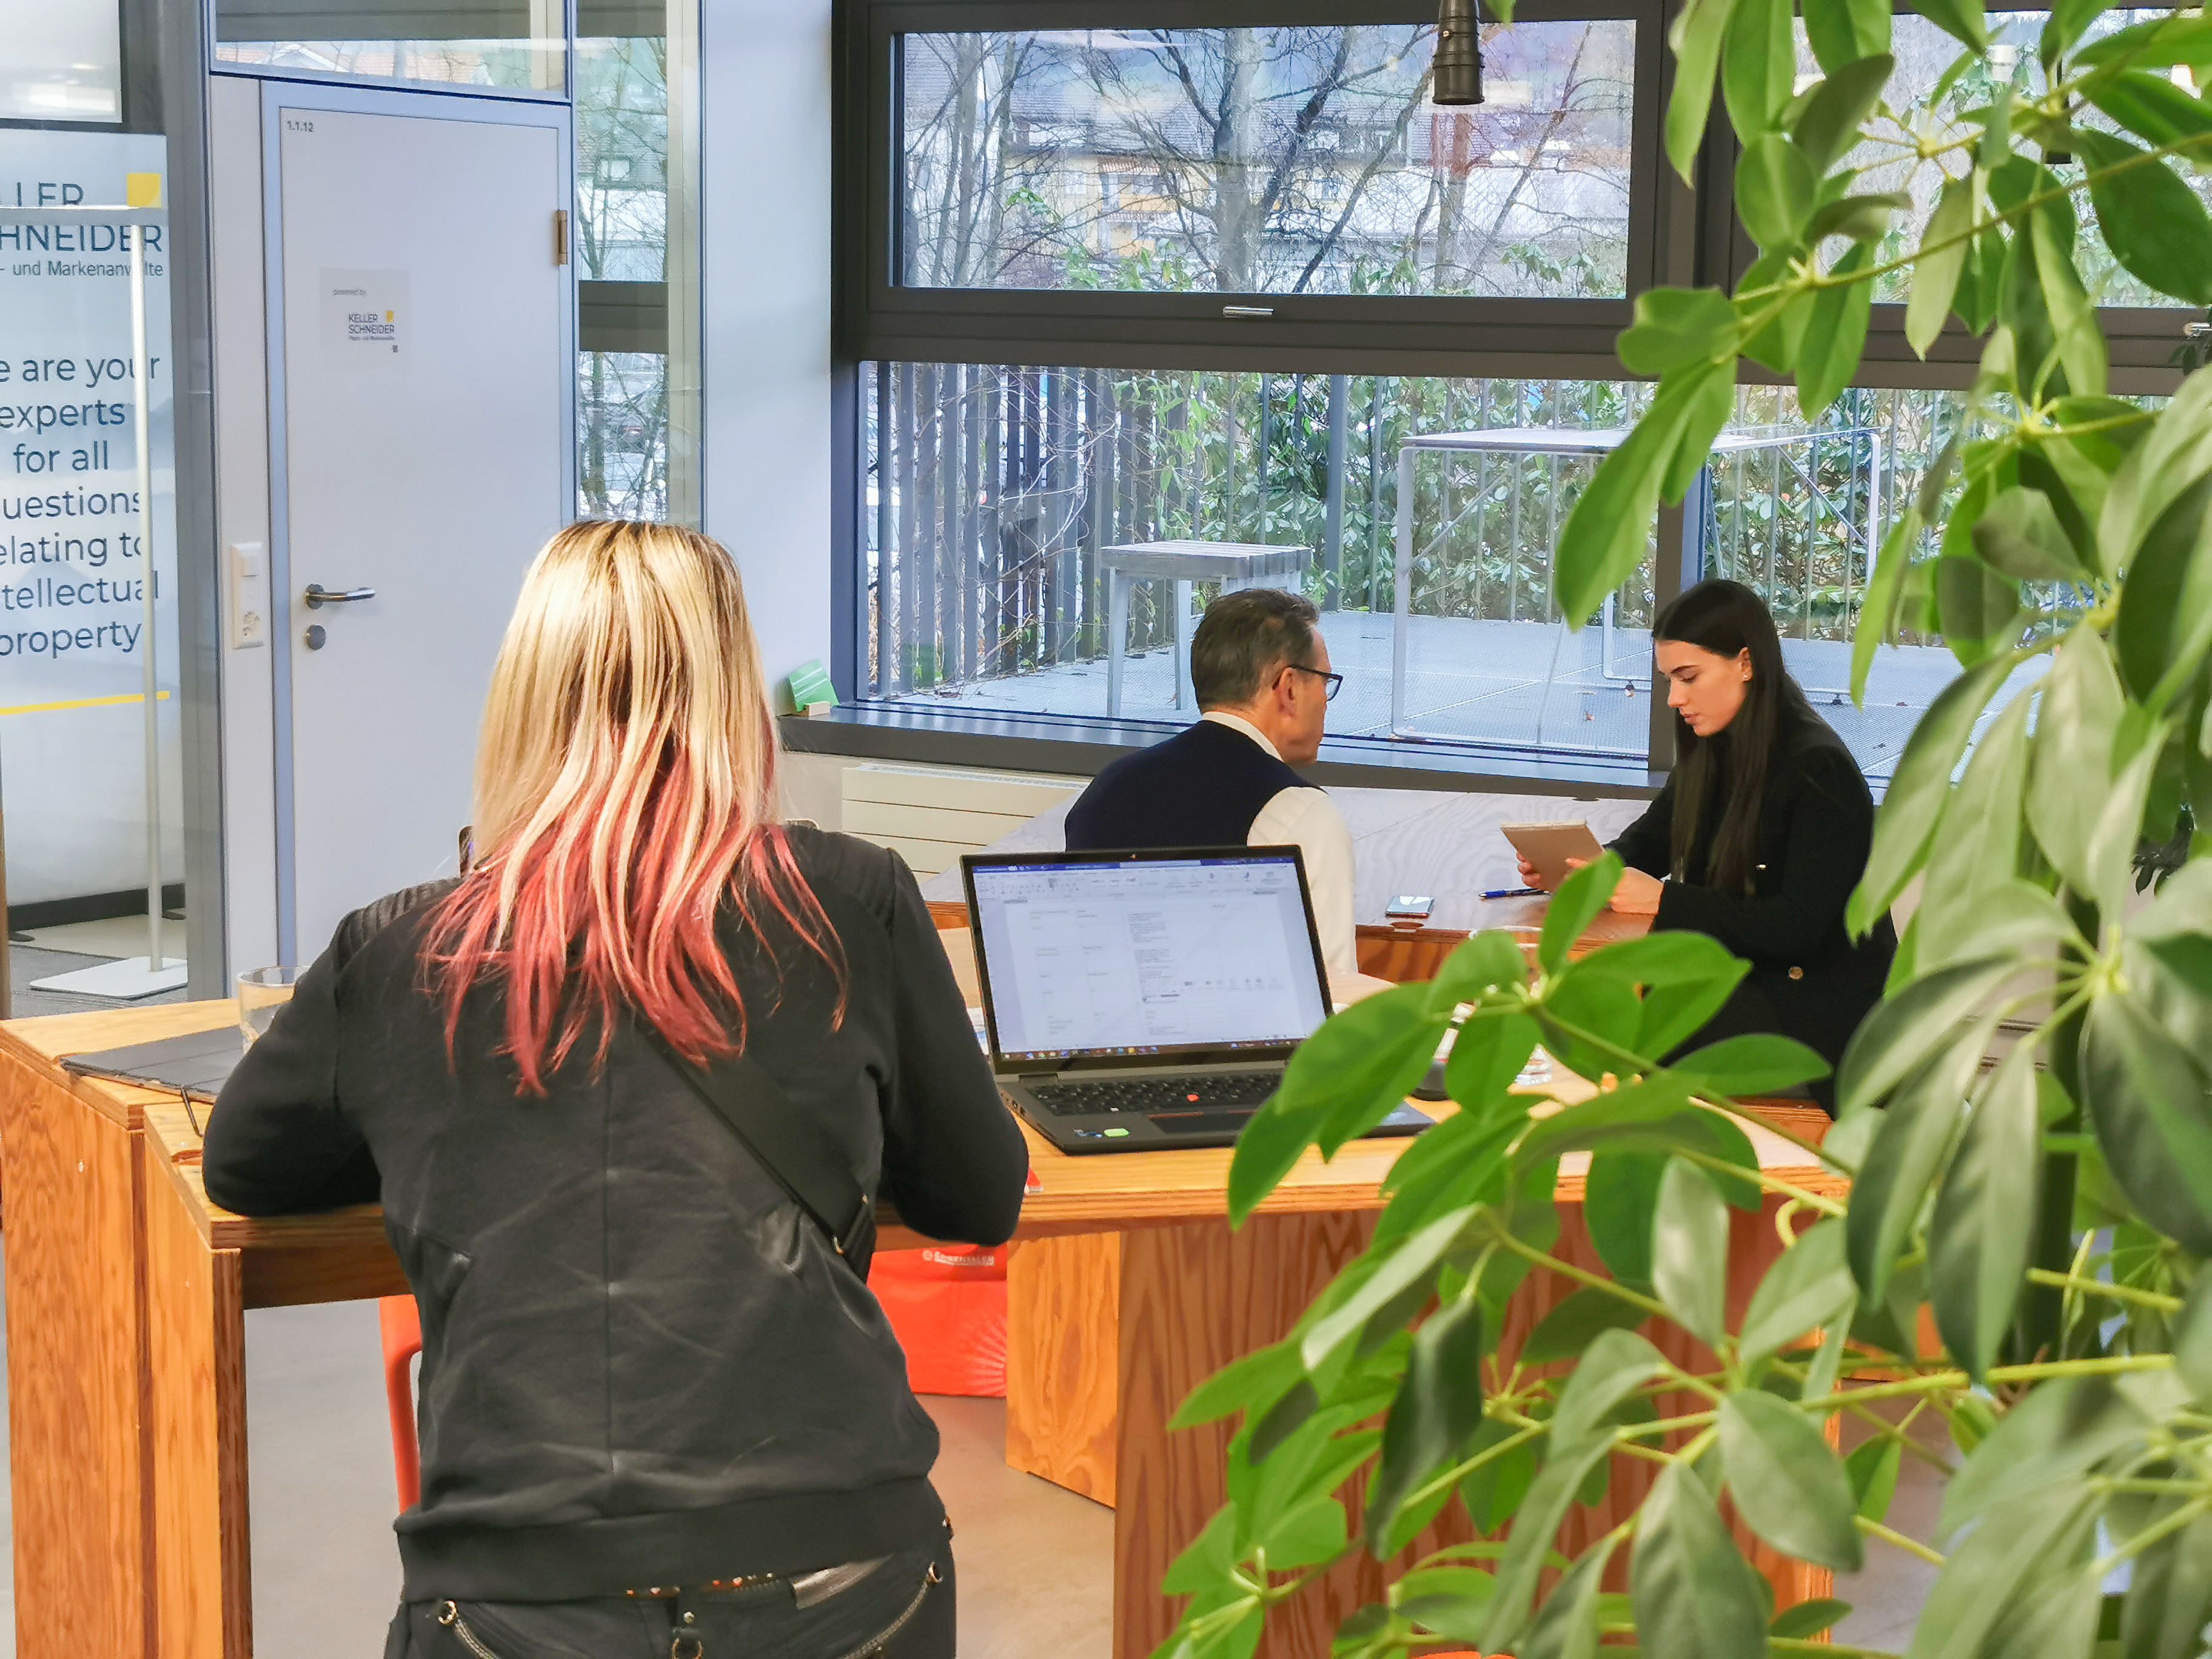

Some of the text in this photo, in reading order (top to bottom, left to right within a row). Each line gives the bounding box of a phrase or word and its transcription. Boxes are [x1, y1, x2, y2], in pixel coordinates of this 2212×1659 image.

[287, 121, 313, 132] 1.1.12
[13, 260, 163, 276] und Markenanlte
[348, 313, 378, 323] KELLER
[348, 324, 394, 334] SCHNEIDER
[22, 359, 76, 382] are
[0, 399, 126, 435] experts
[13, 440, 109, 474] for all
